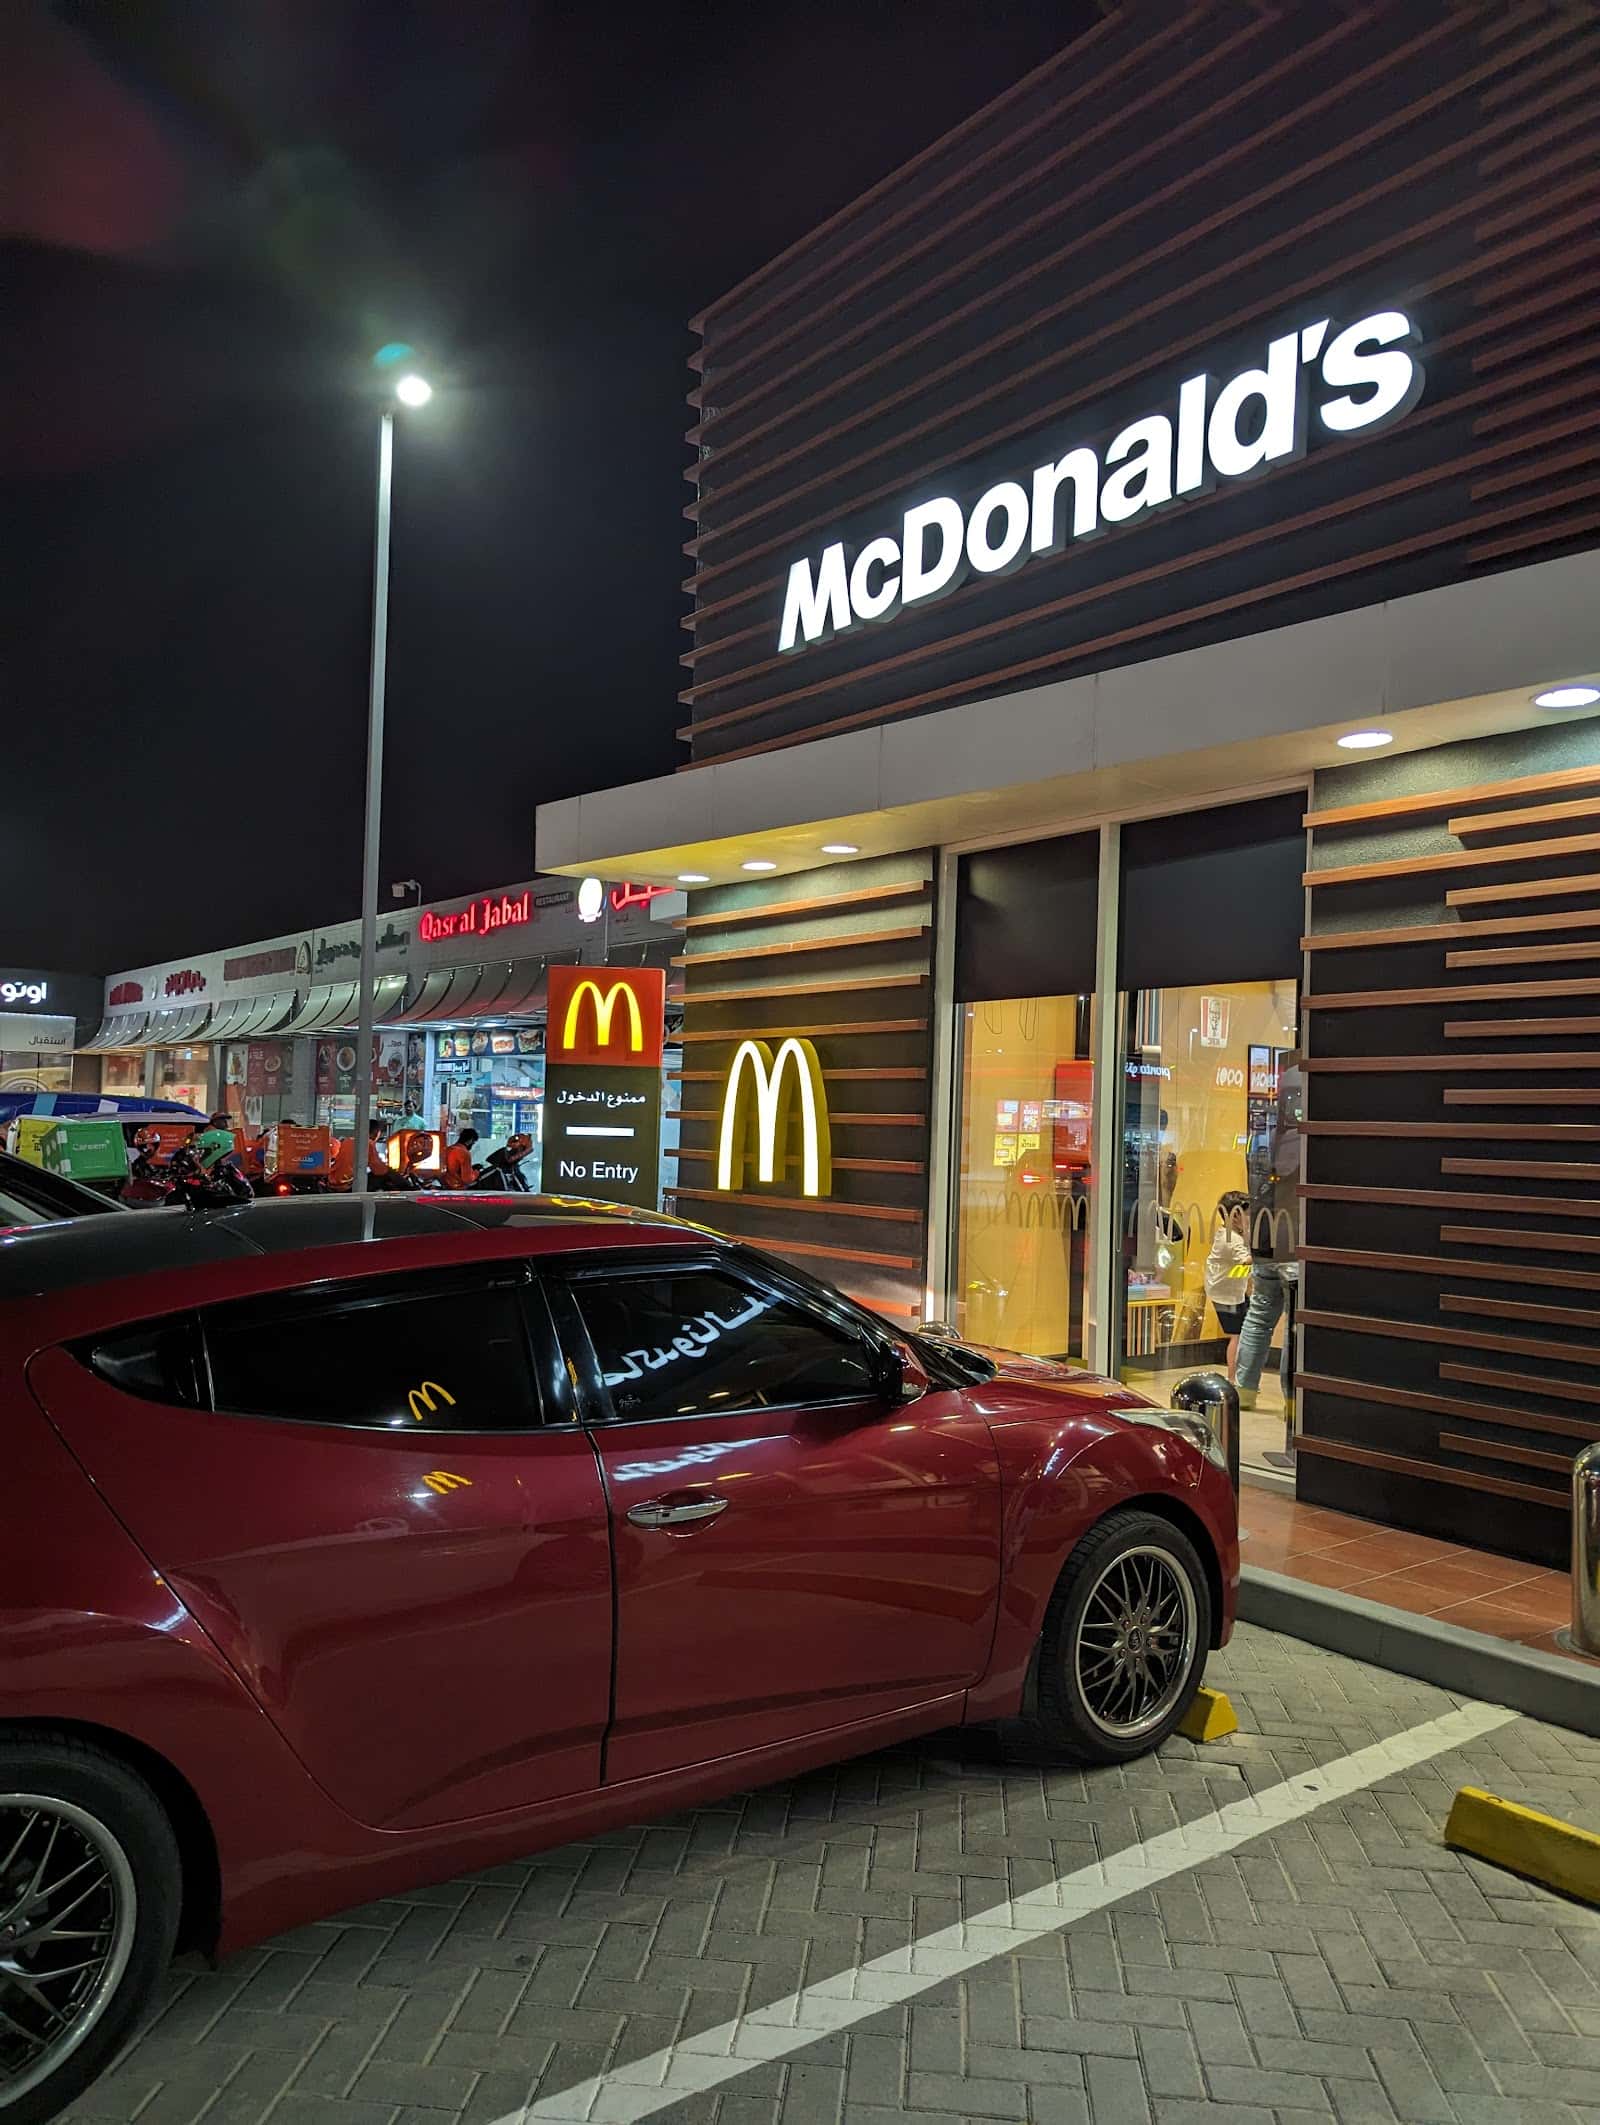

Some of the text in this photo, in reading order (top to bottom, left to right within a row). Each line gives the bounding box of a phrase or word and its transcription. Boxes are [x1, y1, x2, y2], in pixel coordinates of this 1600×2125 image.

[778, 311, 1414, 652] McDonald's
[420, 912, 457, 941] Qasr
[460, 903, 476, 933] al
[479, 891, 530, 936] Jabal
[557, 1090, 647, 1108] ممنوع الدخول
[560, 1161, 638, 1183] No Entry
